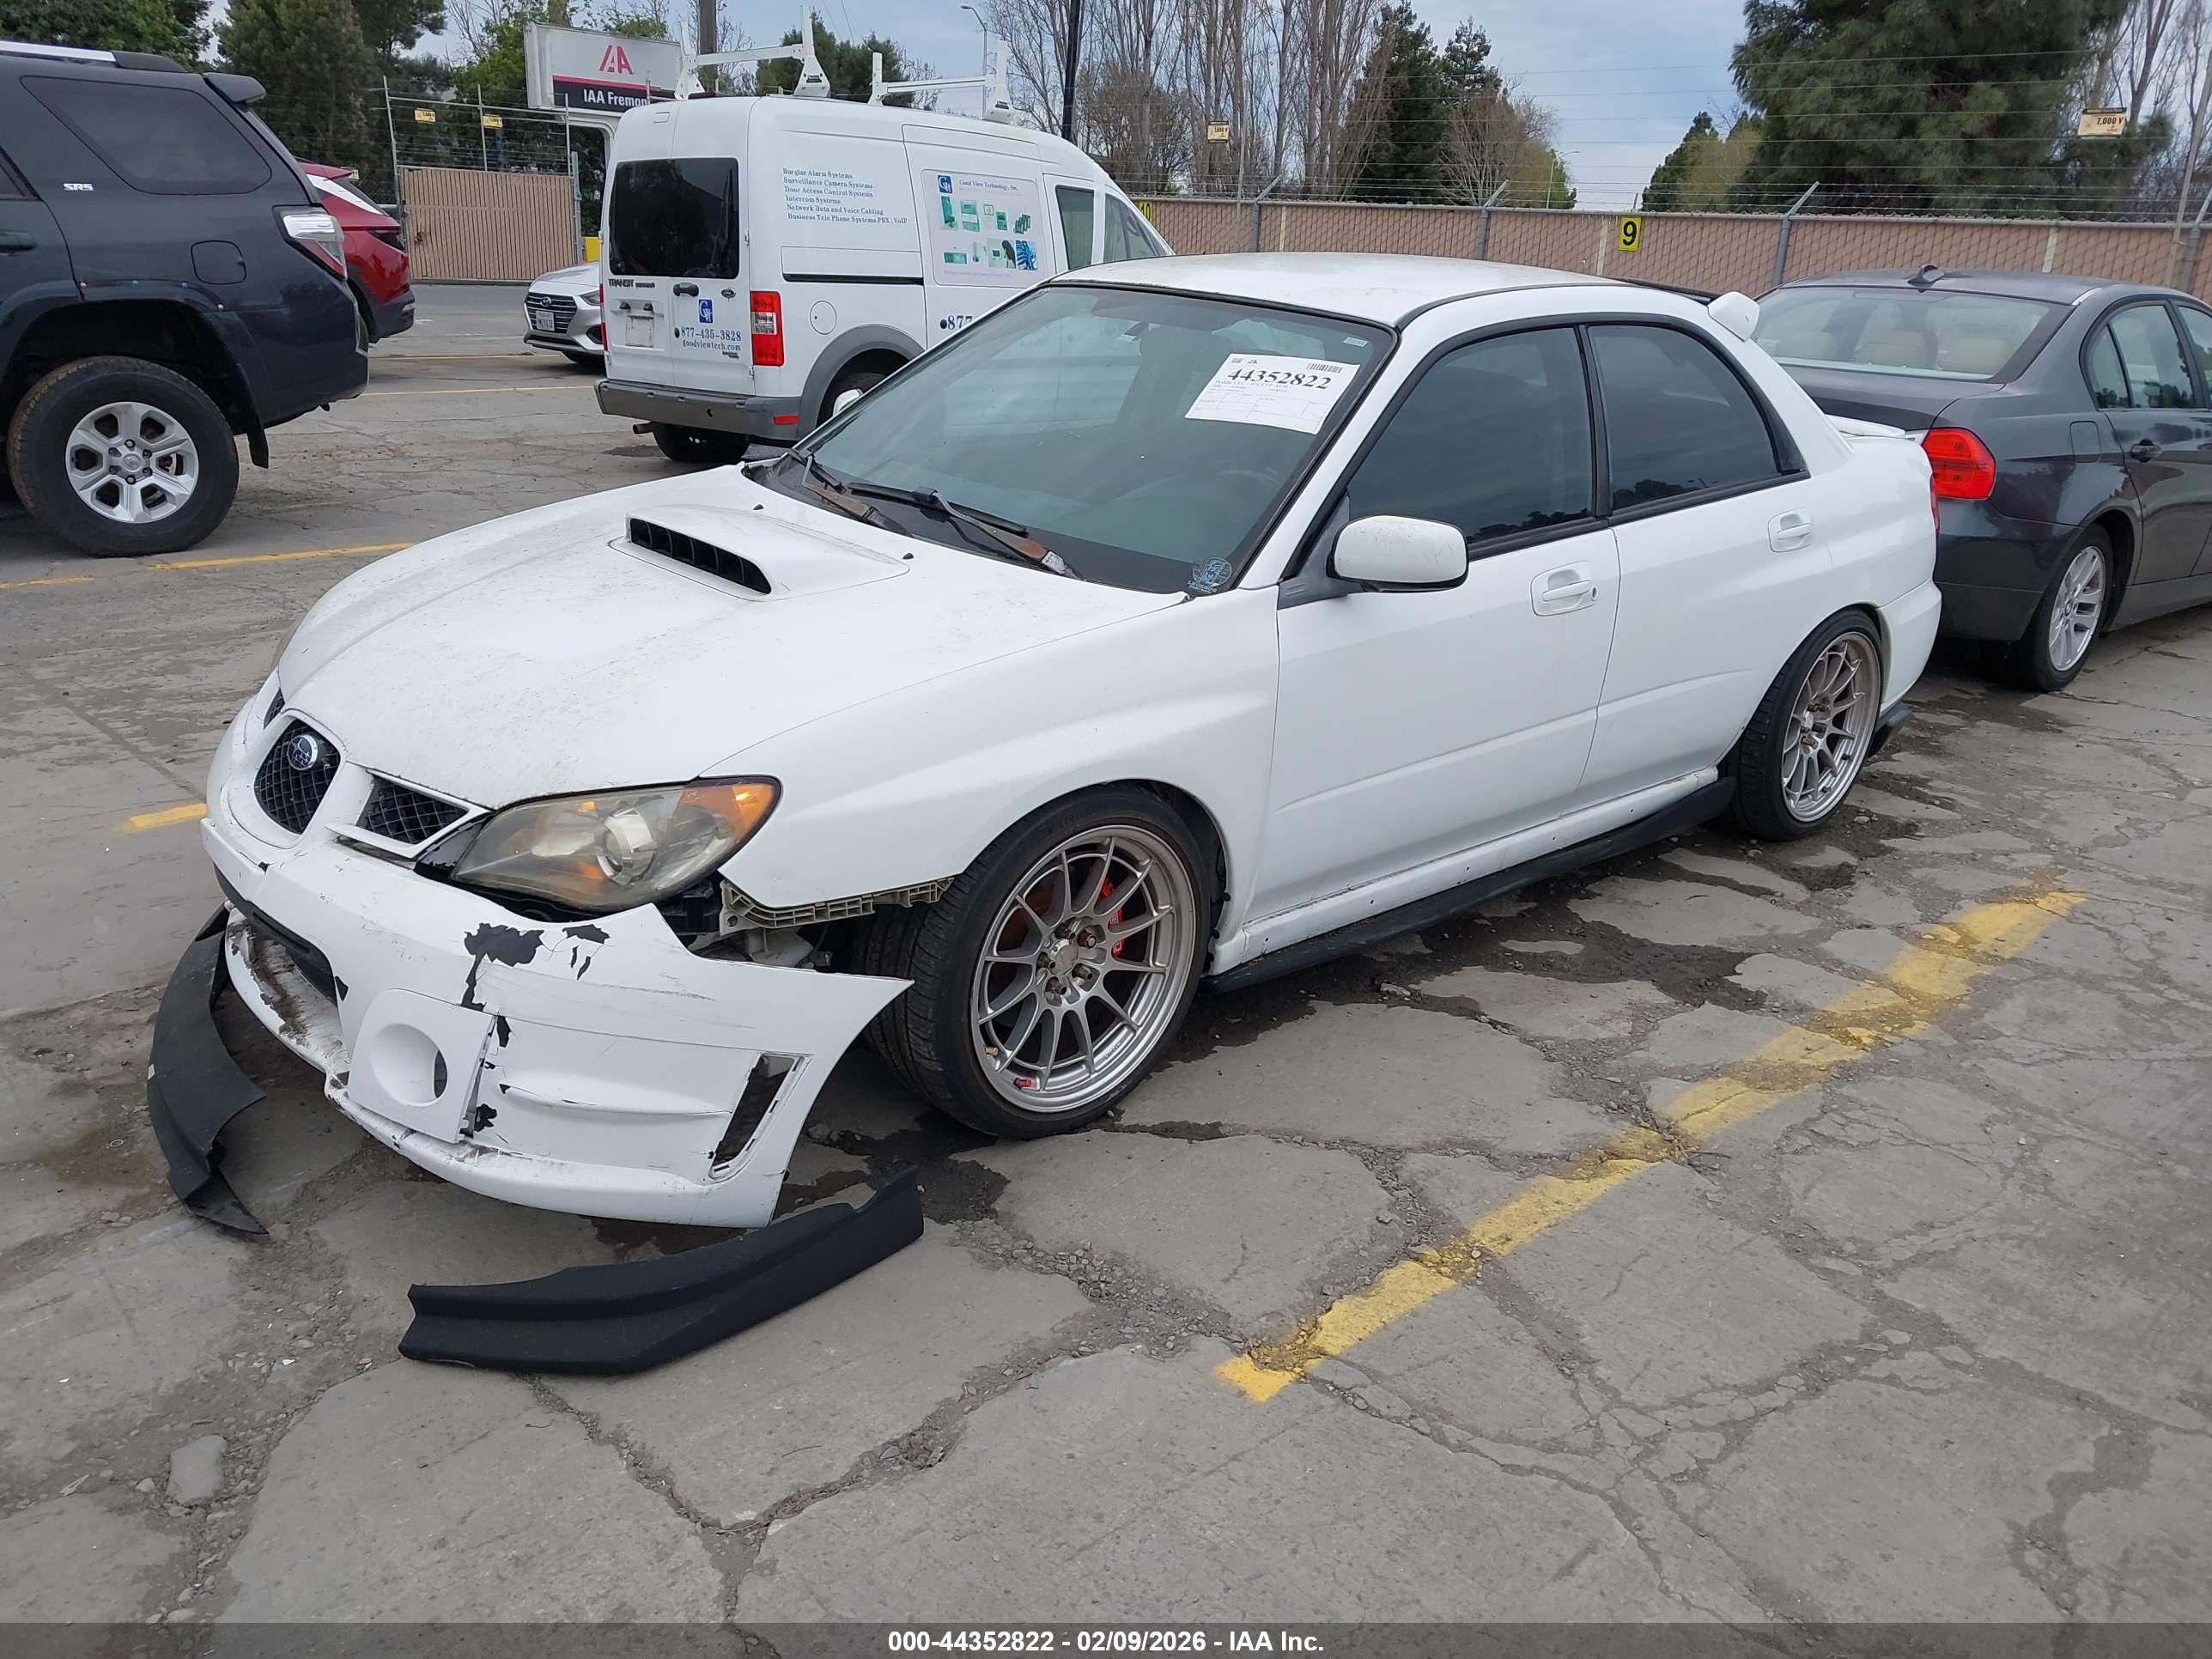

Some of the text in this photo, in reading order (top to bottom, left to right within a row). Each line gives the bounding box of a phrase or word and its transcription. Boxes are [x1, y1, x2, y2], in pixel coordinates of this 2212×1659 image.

[584, 88, 647, 107] IAA Fremon
[2096, 117, 2117, 126] 7,000
[782, 167, 807, 176] Burglar
[783, 176, 823, 185] Surveillance
[848, 181, 873, 190] Systems
[786, 194, 815, 203] Intercom
[823, 188, 848, 197] Control
[848, 190, 873, 198] Systems
[787, 203, 814, 211] Network
[860, 207, 884, 216] Cabling
[787, 212, 816, 221] Business
[1623, 220, 1638, 246] 9
[681, 326, 742, 342] 877-435-3828
[683, 338, 742, 352] goodviewtech.com
[1227, 368, 1332, 390] 44352822
